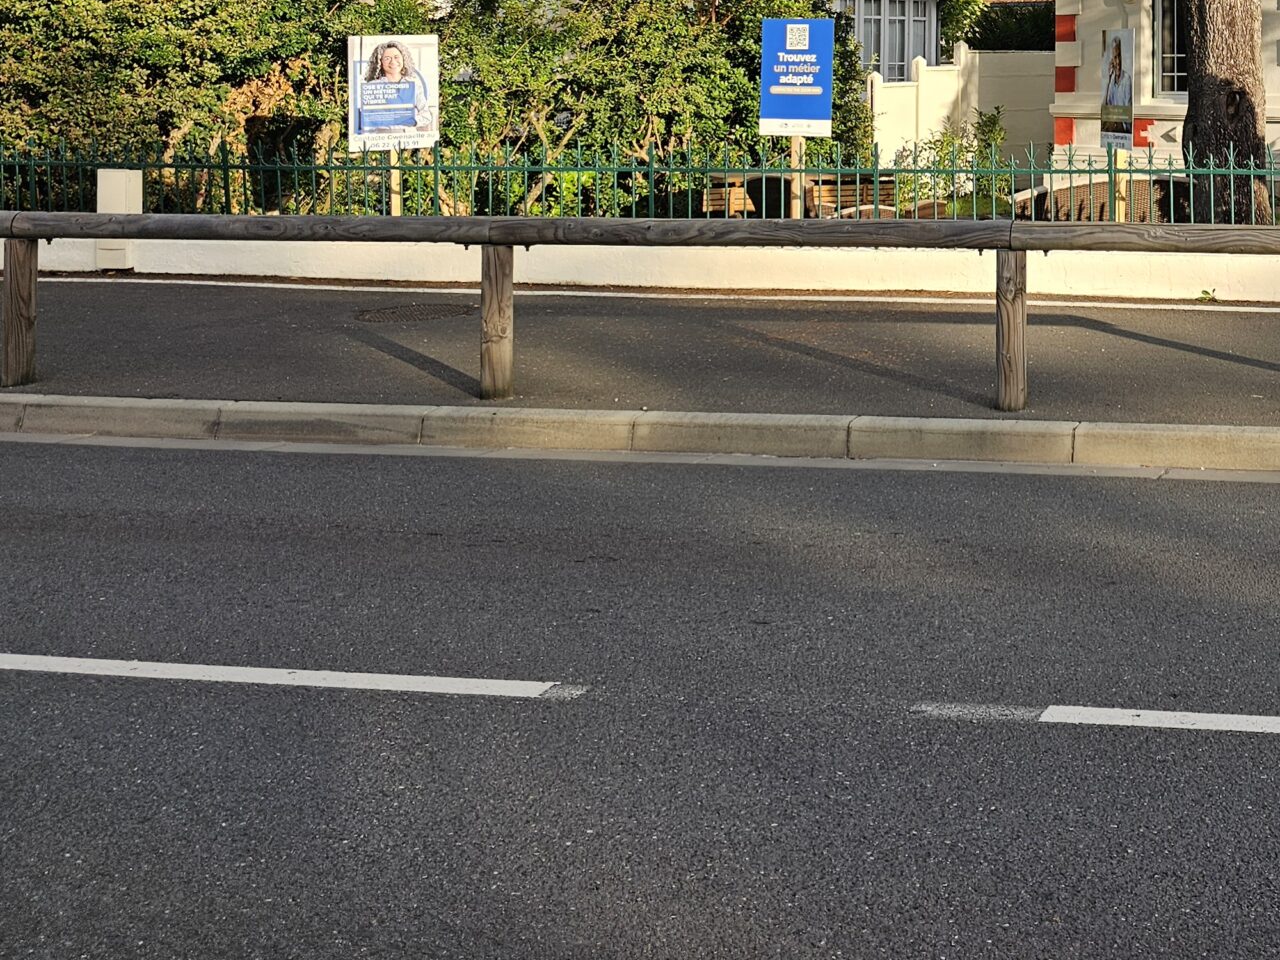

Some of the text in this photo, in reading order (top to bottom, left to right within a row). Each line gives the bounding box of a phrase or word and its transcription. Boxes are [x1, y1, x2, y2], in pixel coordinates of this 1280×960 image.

[777, 52, 816, 62] Trouvez
[774, 62, 820, 72] un métier
[779, 73, 814, 86] adapté
